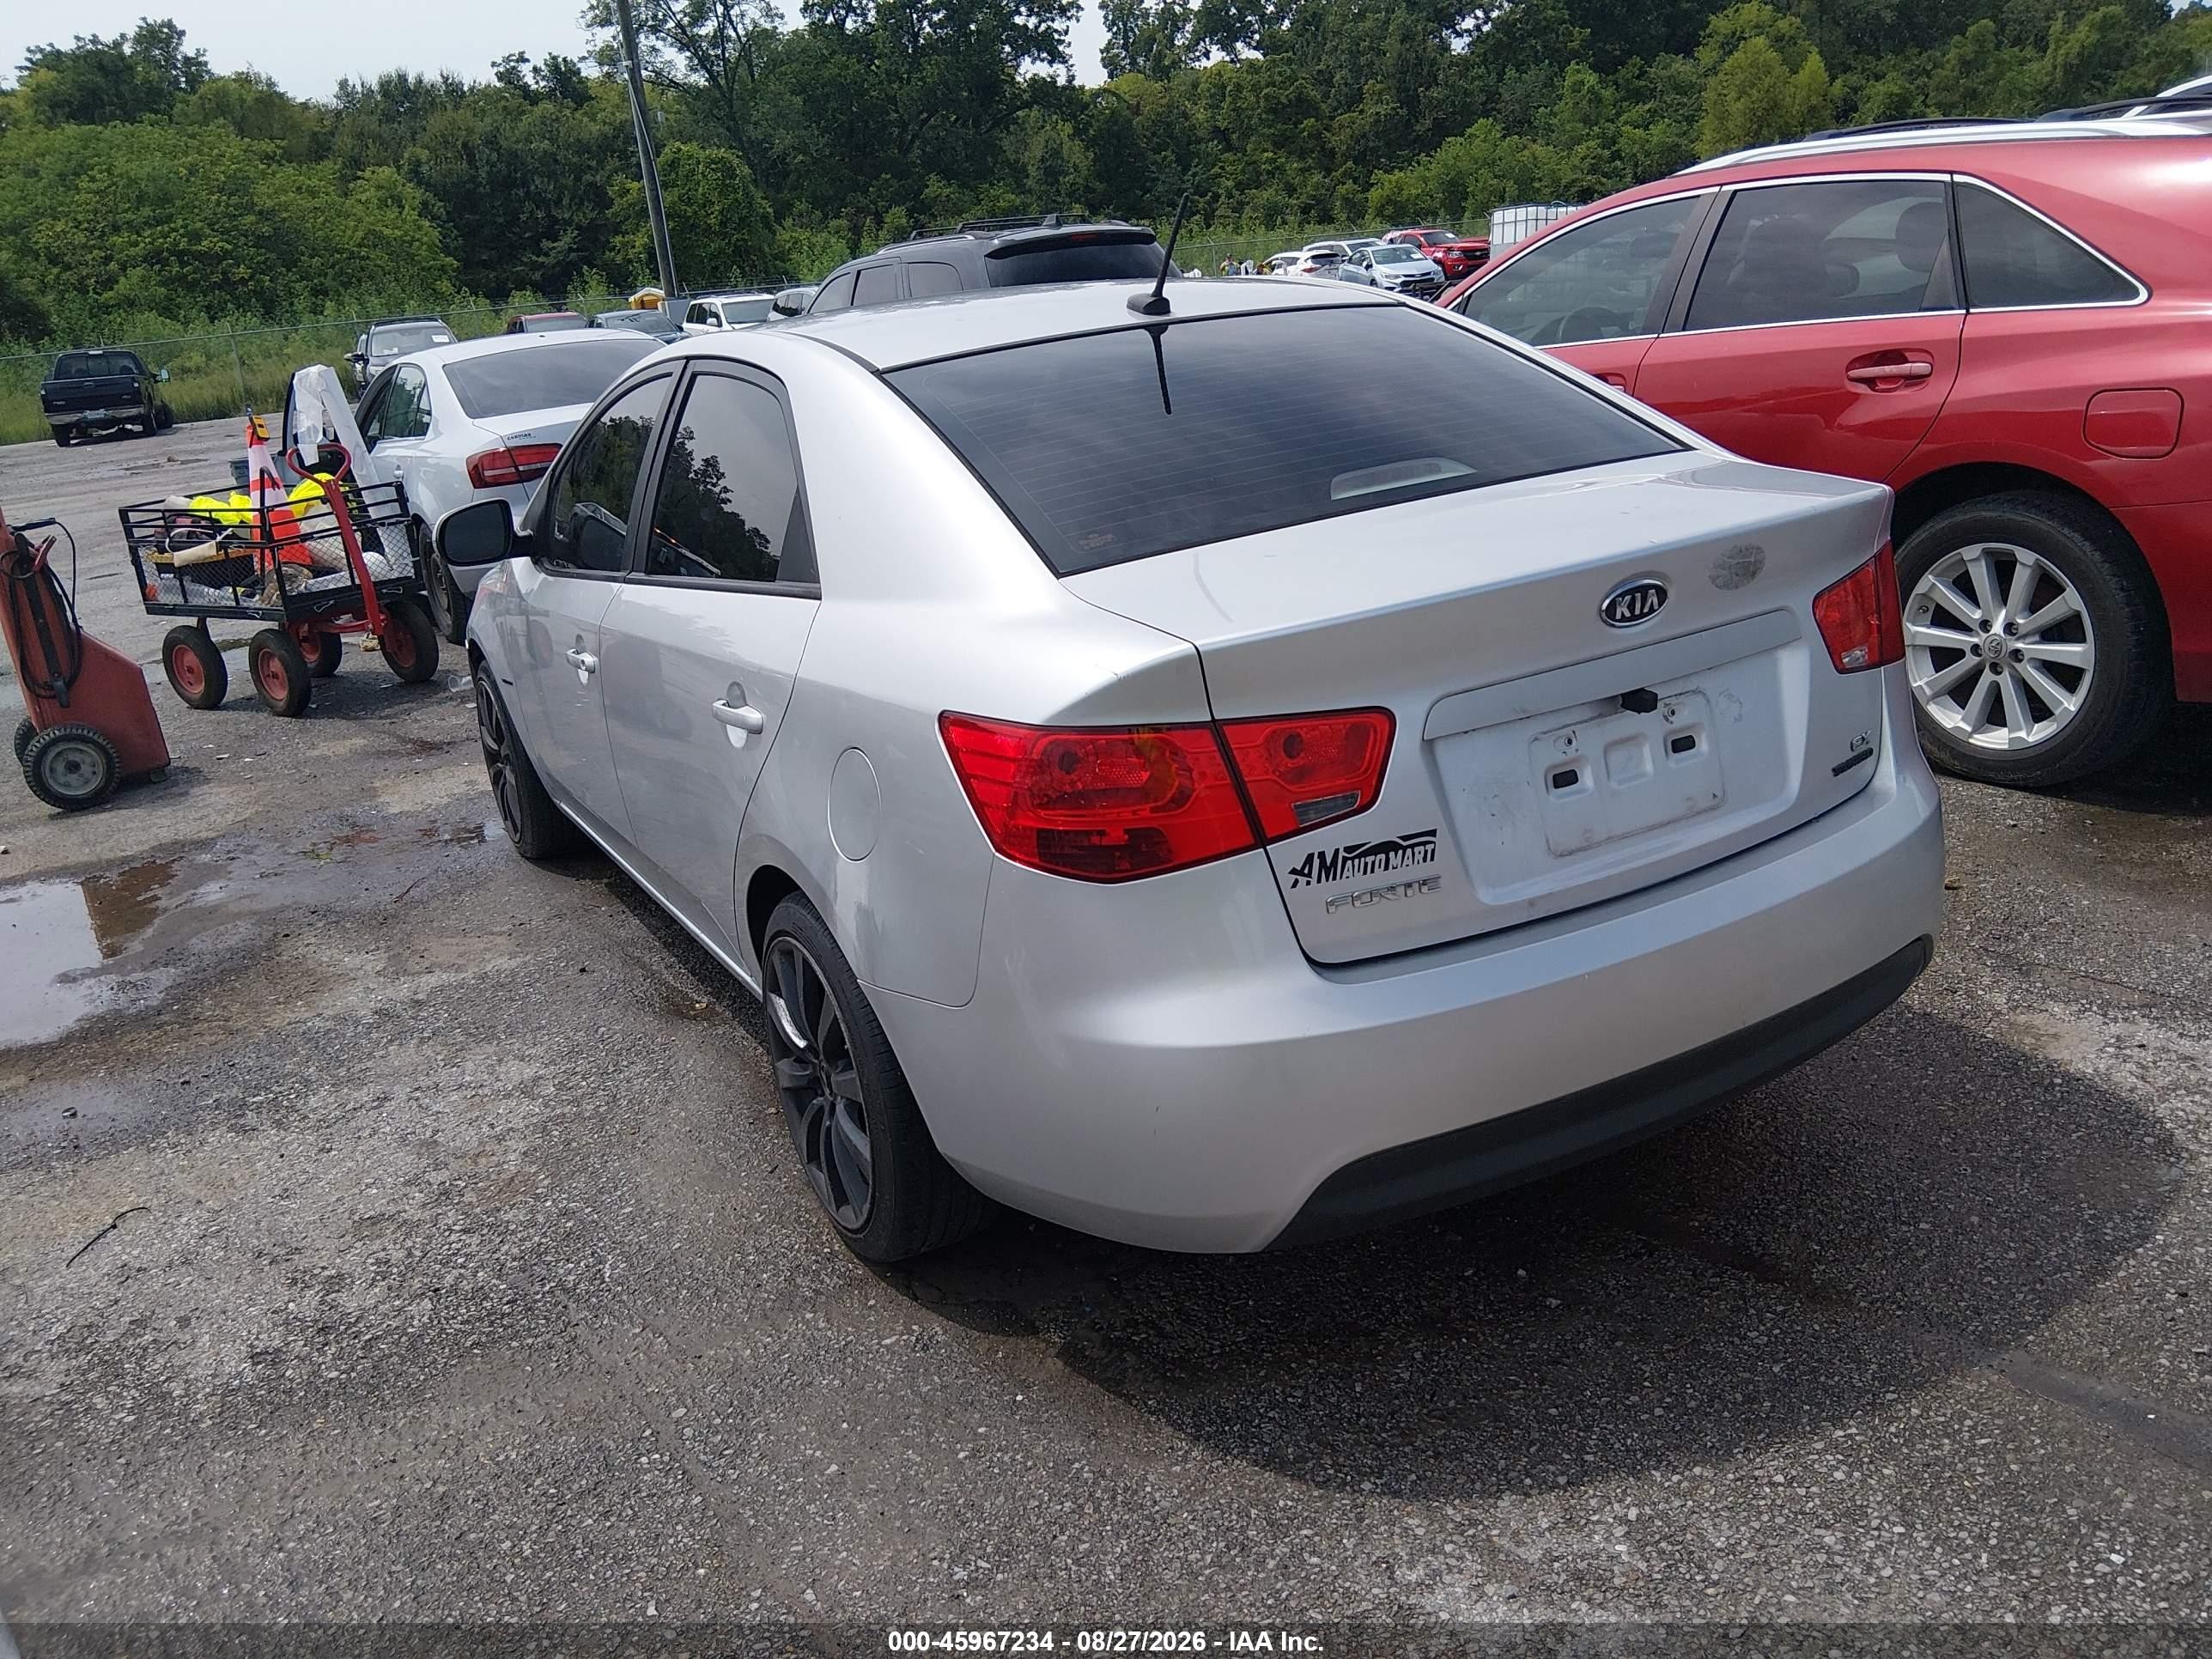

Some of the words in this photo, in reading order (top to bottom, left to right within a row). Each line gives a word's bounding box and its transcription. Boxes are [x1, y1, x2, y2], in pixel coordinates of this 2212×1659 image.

[1614, 589, 1660, 620] KIA
[1287, 848, 1340, 890] AM
[1340, 853, 1386, 880] AUTO
[1388, 842, 1436, 871] MART
[1325, 874, 1443, 915] FORTE
